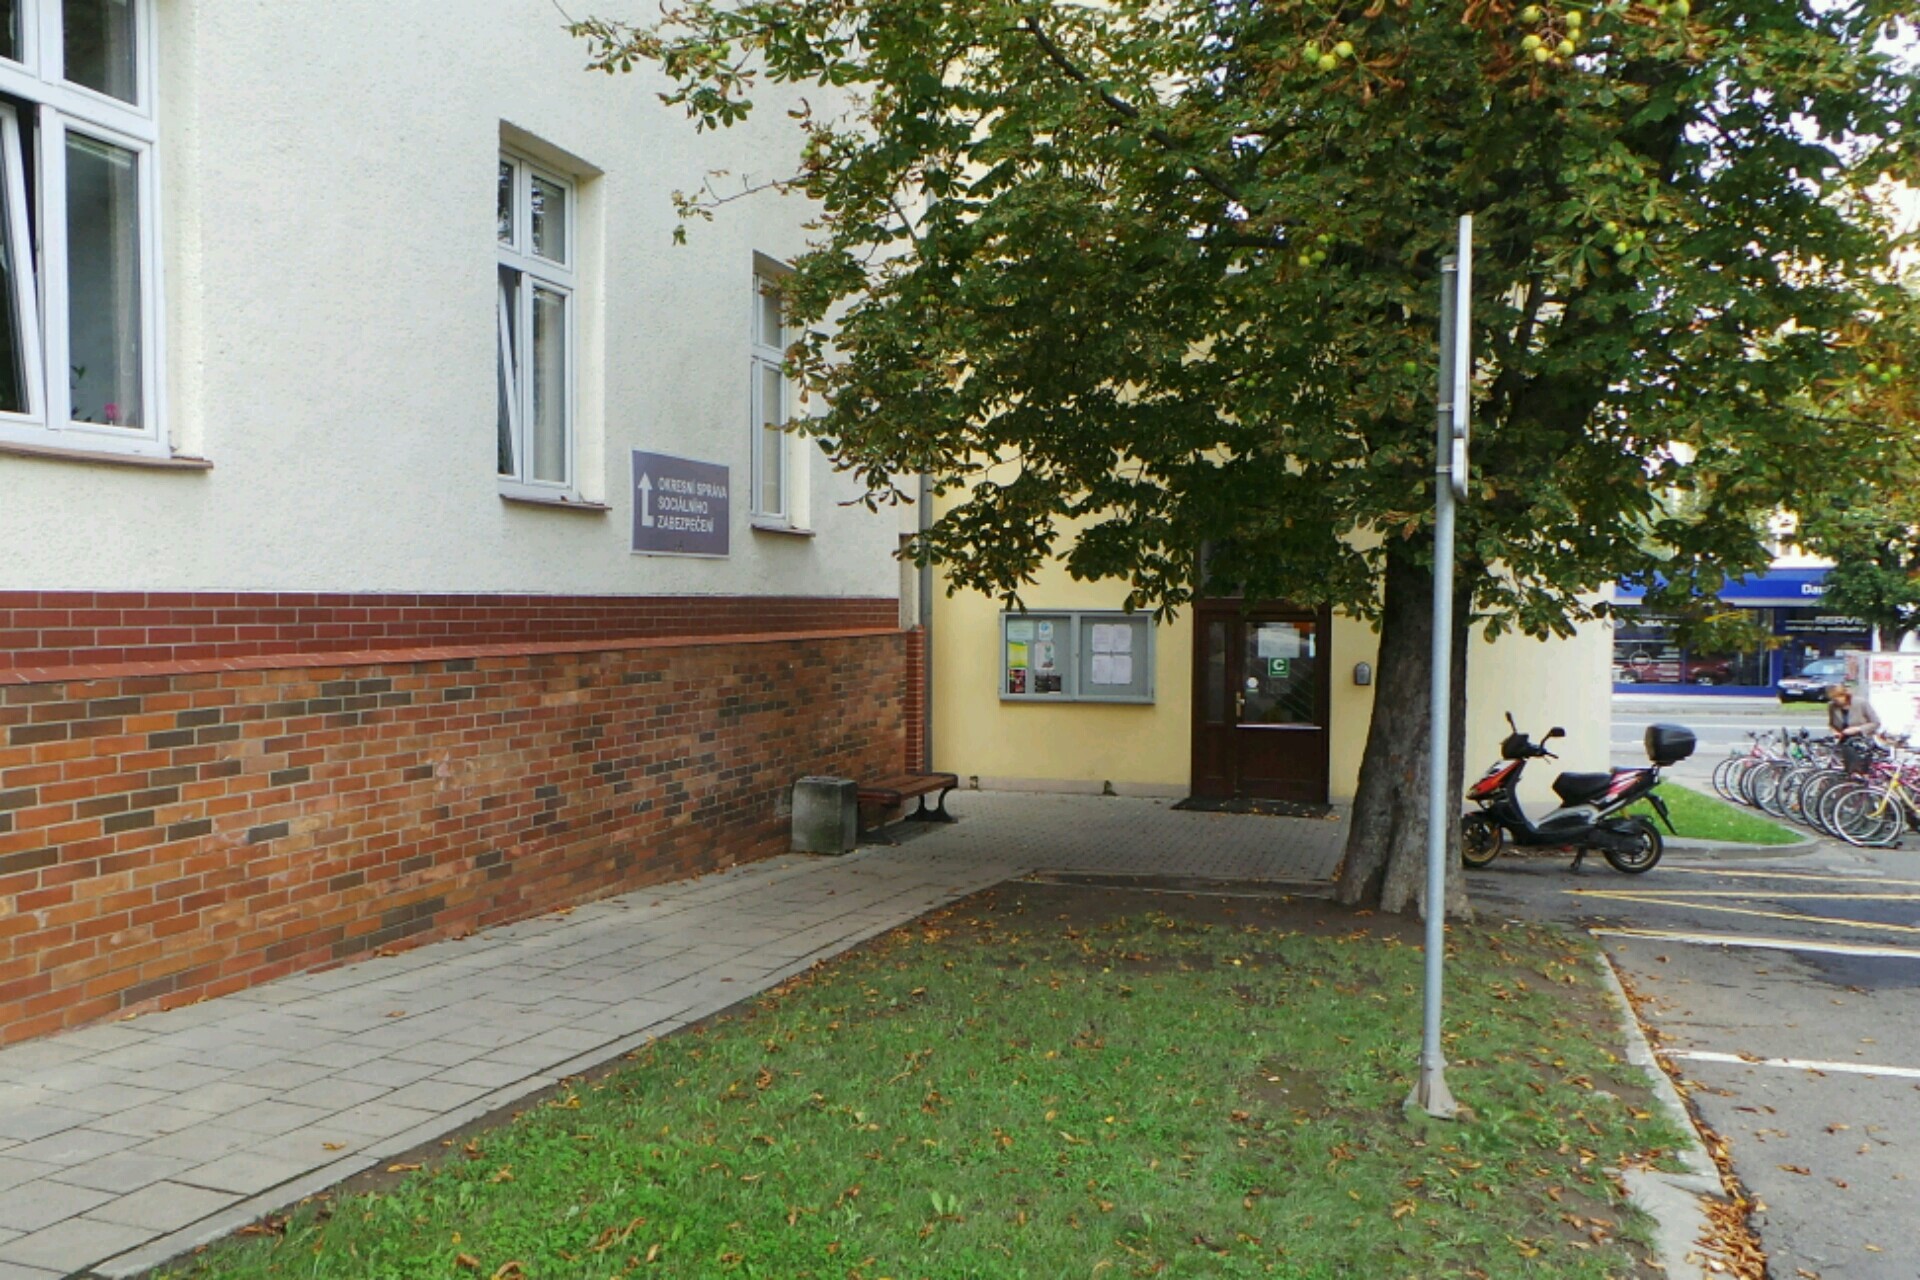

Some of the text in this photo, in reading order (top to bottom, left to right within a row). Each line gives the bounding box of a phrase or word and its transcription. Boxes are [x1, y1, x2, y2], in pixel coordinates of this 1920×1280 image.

[657, 477, 728, 499] OKRESNÍ SPRÁVA
[657, 495, 708, 514] SOCIÁLNÍHO
[657, 515, 714, 533] ZABEZPEČENÍ
